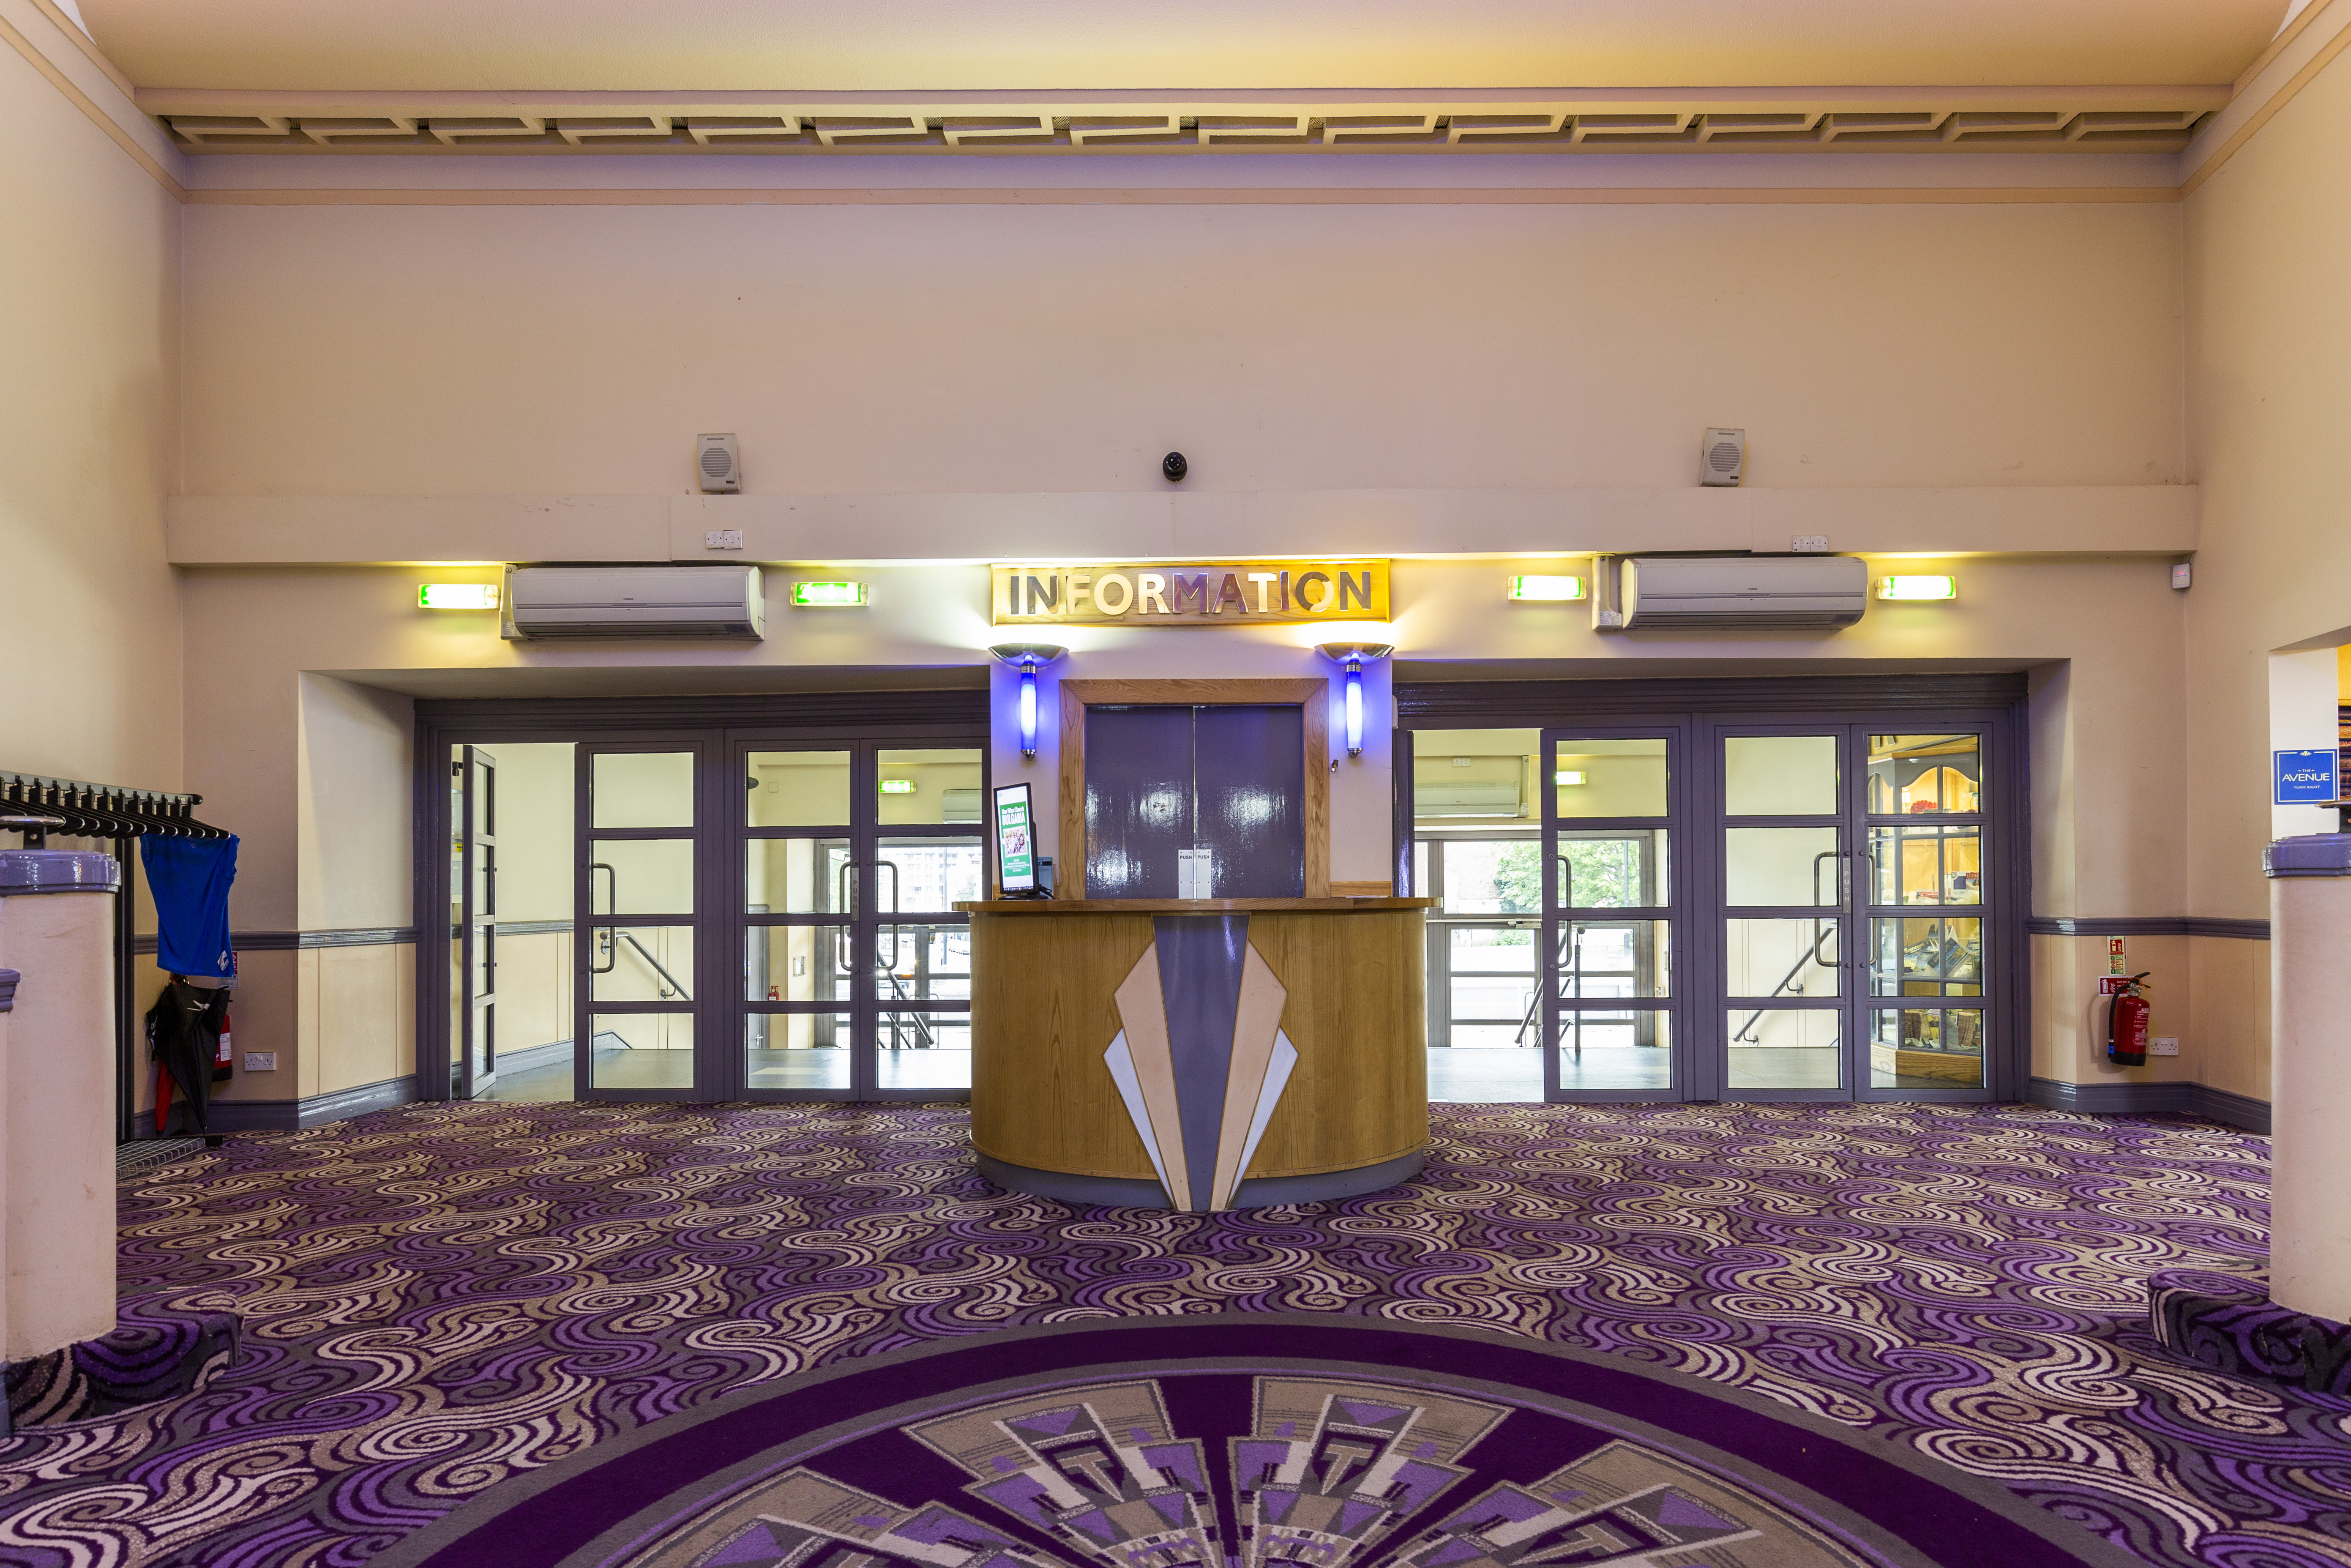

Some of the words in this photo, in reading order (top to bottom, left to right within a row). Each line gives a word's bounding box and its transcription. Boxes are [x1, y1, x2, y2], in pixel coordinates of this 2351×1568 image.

[1010, 571, 1372, 615] INFORMATION
[2282, 773, 2330, 781] AVENUE
[1002, 812, 1026, 826] BULGARIA
